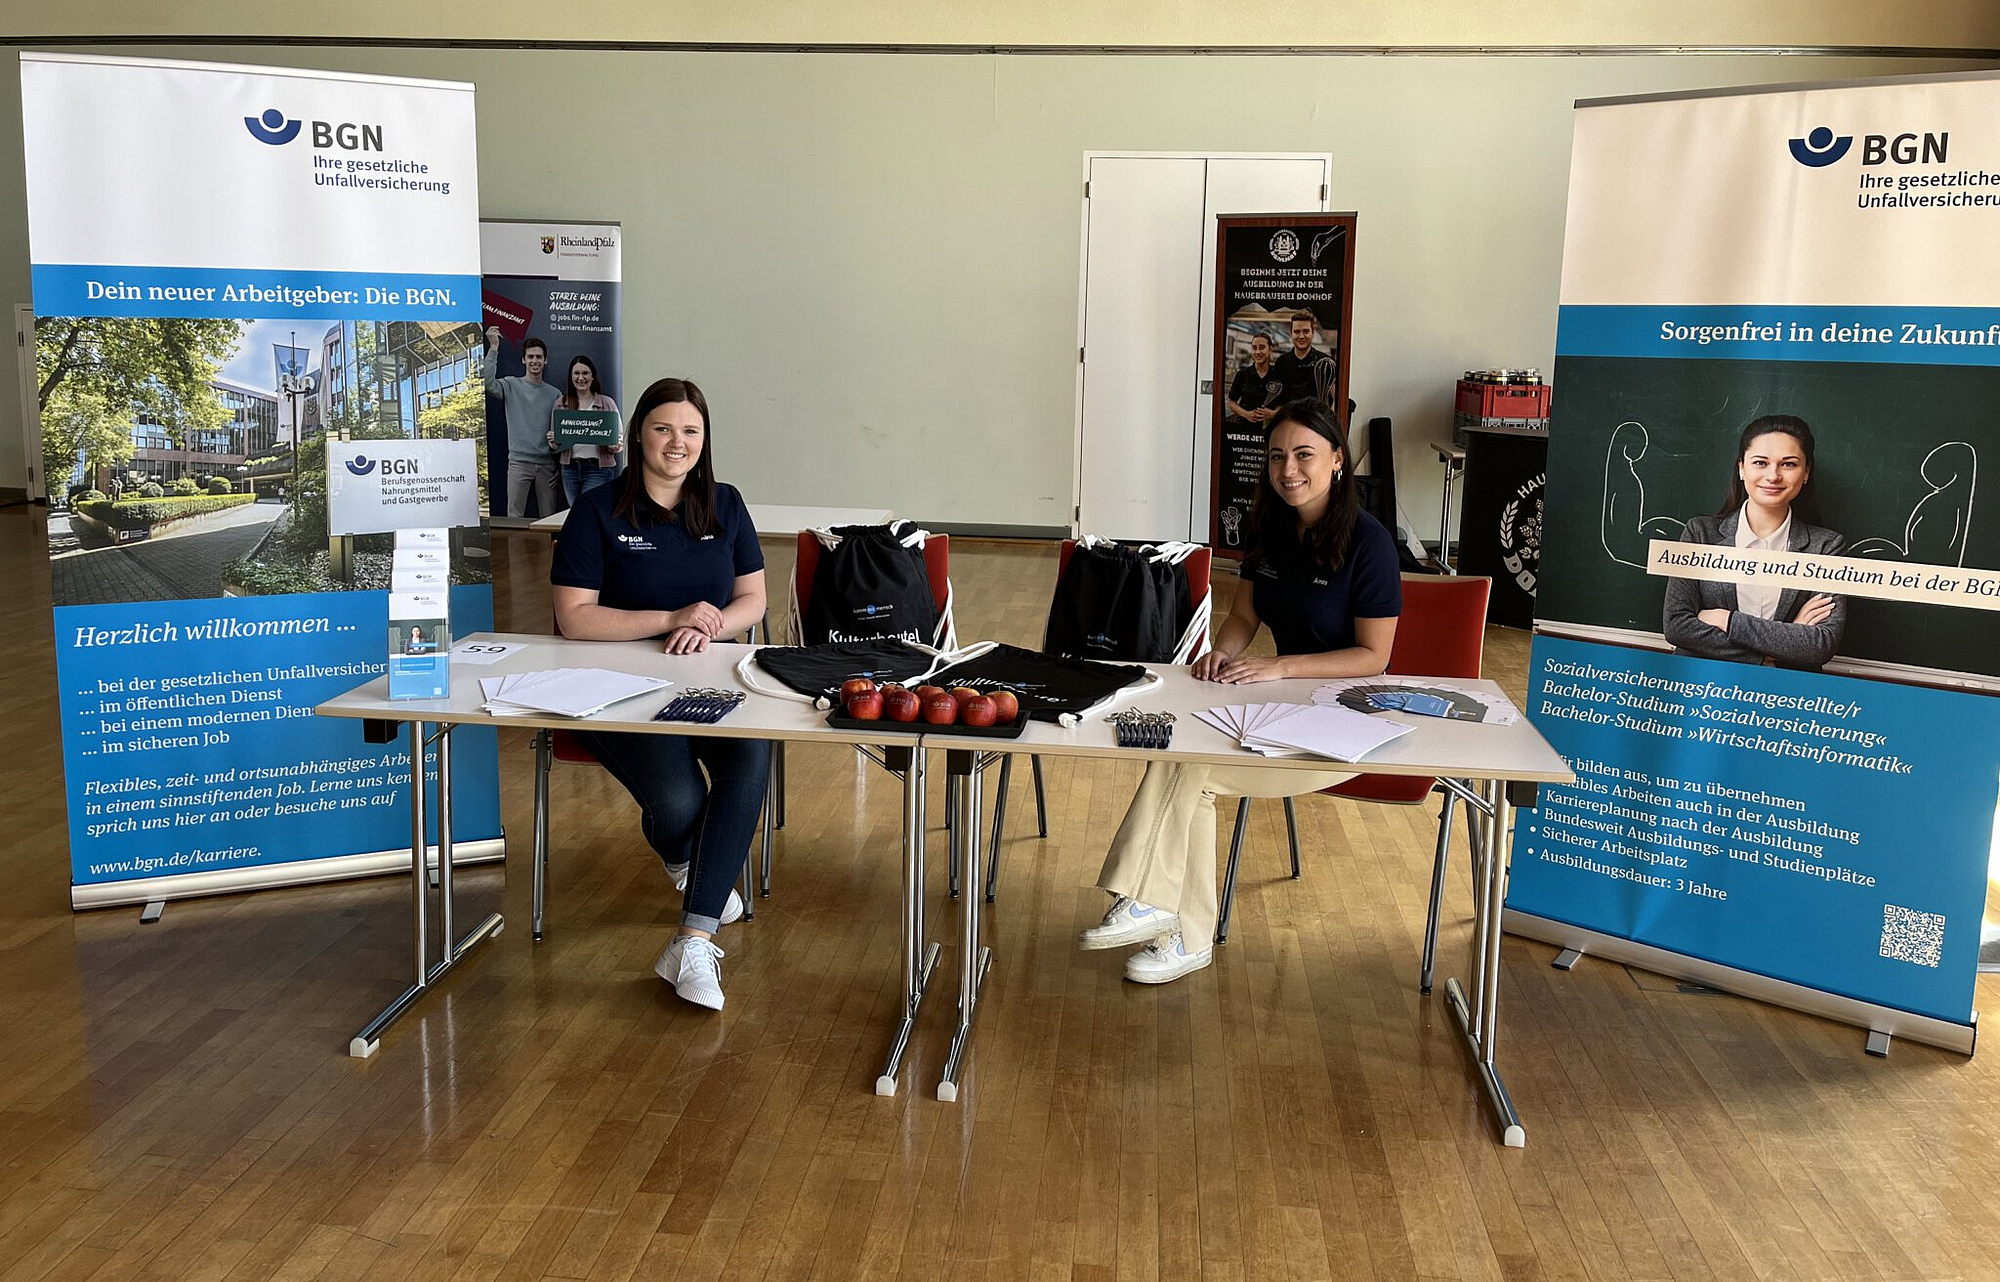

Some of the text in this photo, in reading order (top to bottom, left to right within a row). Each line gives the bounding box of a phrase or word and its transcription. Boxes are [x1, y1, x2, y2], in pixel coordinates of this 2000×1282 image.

[311, 120, 384, 152] BGN
[1861, 131, 1950, 166] BGN
[313, 155, 429, 176] Ihre gesetzliche
[1859, 170, 2000, 191] Ihre gesetzliche
[314, 173, 451, 195] Unfallversicherung
[1240, 268, 1328, 277] BEGINNE JETZT DEINE
[1242, 280, 1324, 289] AUSBILDUNG IN DER
[86, 280, 457, 307] Dein neuer Arbeitgeber: Die BGN.
[550, 291, 602, 302] STARTE DEINE
[1234, 291, 1295, 300] HAUSBRAUEREI
[1660, 320, 2000, 346] Sorgenfrei in deine Zukunf
[381, 459, 419, 475] BGN
[381, 475, 466, 486] Berufsgenossenschaft
[381, 485, 442, 496] Nahrungsmittel
[382, 495, 449, 506] und Gastgewerbe
[1503, 552, 1537, 598] DO
[1658, 549, 1757, 576] Ausbildung
[1762, 562, 1799, 577] und
[1803, 562, 1884, 585] Studium
[1889, 570, 1920, 589] bei
[1925, 574, 1960, 592] der
[74, 621, 178, 648] Herzlich
[185, 617, 330, 643] willkommen
[98, 679, 125, 695] bei
[129, 675, 156, 692] der
[161, 669, 263, 693] gesetzlichen
[1544, 657, 1862, 719] Sozialversicherungsfachangestellte/r
[100, 700, 121, 714] im
[126, 690, 226, 712] öffentlichen
[231, 687, 282, 705] Dienst
[1542, 678, 1888, 747] Bachelor-Studium »Sozialversicherung«
[101, 719, 127, 734] bei
[131, 714, 183, 732] einem
[187, 707, 271, 727] modernen
[102, 738, 124, 755] im
[128, 731, 199, 752] sicheren
[203, 730, 230, 748] Job
[1540, 700, 1913, 775] Bachelor-Studium »Wirtschaftsinformatik«
[84, 751, 438, 796] Flexibles, zeit- und ortsunabhängiges Arbee
[1576, 757, 1620, 778] bilden
[1624, 768, 1651, 786] aus,
[1656, 775, 1679, 790] um
[1684, 779, 1702, 793] zu
[1706, 781, 1806, 812] übernehmen
[86, 769, 438, 816] in einem sinnstiftenden Job. Lerne uns kenn
[86, 790, 398, 838] sprich uns hier an oder besuche uns auf
[1545, 789, 1824, 858] Karriereplanung nach der Ausbildung
[1556, 776, 1861, 844] ibles Arbeiten auch in der Ausbildung
[90, 843, 262, 876] www.bgn.de/karriere.
[1542, 825, 1688, 869] Sicherer Arbeitsplatz
[1544, 807, 1877, 888] Bundesweit Ausbildungs- und Studienplätze
[1540, 848, 1728, 900] Ausbildungsdauer: 3 Jahre
